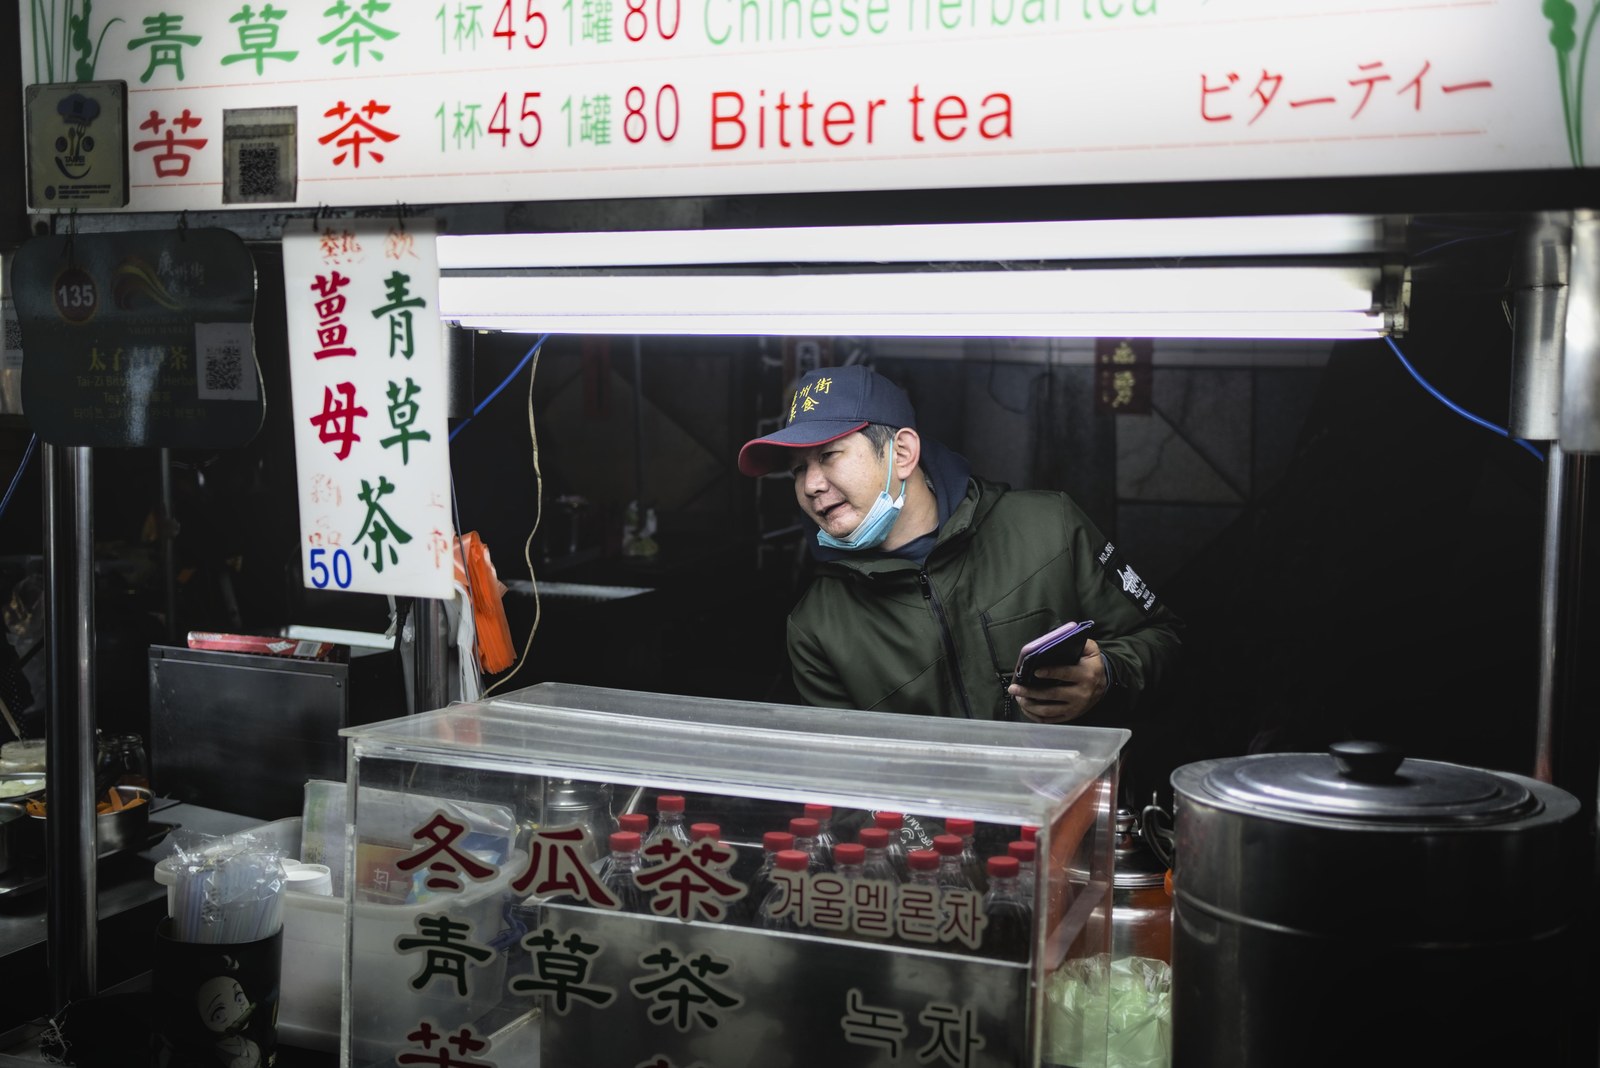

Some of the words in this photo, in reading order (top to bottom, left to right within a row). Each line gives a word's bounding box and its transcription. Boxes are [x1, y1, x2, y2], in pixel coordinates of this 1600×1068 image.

[127, 0, 400, 84] 青草茶
[710, 91, 888, 151] Bitter
[908, 84, 1014, 141] tea
[1200, 60, 1494, 127] ビターティー
[58, 284, 95, 309] 135
[309, 270, 369, 462] 薑母
[353, 270, 432, 574] 青草茶
[309, 548, 353, 590] 50
[396, 813, 743, 921] 冬瓜茶
[772, 875, 982, 942] 겨울멜론차
[397, 916, 741, 1029] 青草茶
[845, 992, 981, 1068] 녹차
